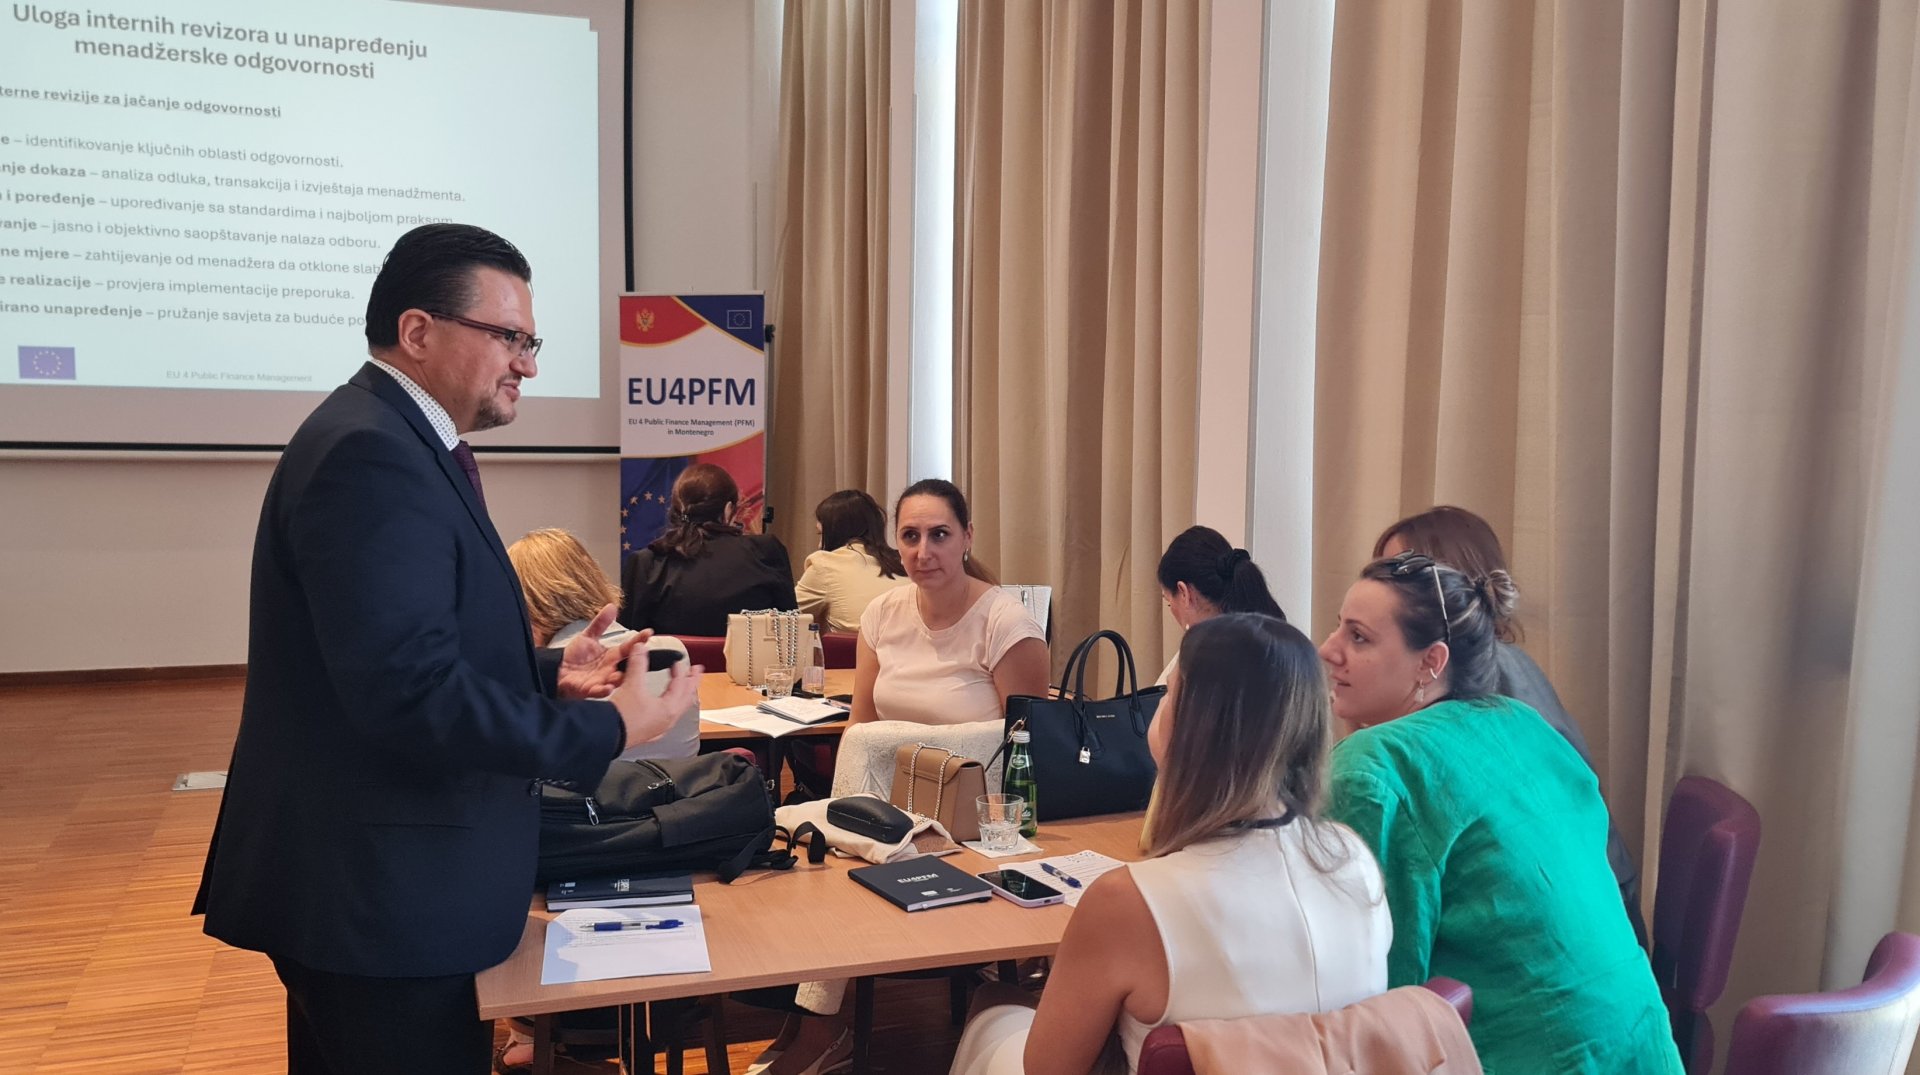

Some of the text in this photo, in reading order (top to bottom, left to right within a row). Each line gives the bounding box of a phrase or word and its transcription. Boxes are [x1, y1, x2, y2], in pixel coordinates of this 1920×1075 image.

[13, 3, 427, 61] Uloga internih revizora u unapređenju
[75, 40, 375, 79] menadžerske odgovornosti
[44, 90, 100, 105] revizije
[104, 96, 121, 105] za
[124, 94, 180, 112] jačanje
[184, 100, 282, 118] odgovornosti
[26, 134, 134, 155] identifikovanje
[138, 142, 195, 158] ključnih
[198, 147, 247, 161] oblasti
[250, 152, 344, 168] odgovornosti.
[30, 163, 87, 178] dokaza
[102, 169, 154, 182] analiza
[157, 172, 212, 187] odluka,
[214, 176, 291, 193] transakcija
[302, 180, 364, 198] izvještaja
[366, 186, 466, 203] menadžmenta.
[6, 189, 11, 201] i
[208, 204, 226, 216] sa
[228, 204, 317, 219] standardima
[327, 209, 394, 226] najboljom
[52, 219, 93, 234] jasno
[104, 224, 181, 239] objektivno
[184, 229, 278, 246] saopštavanje
[281, 233, 326, 247] nalaza
[329, 236, 381, 250] odboru.
[24, 246, 71, 261] mjere
[85, 250, 173, 267] zahtijevanje
[176, 254, 194, 267] od
[198, 256, 275, 271] menadžera
[278, 259, 297, 271] da
[299, 260, 350, 274] otklone
[10, 274, 92, 290] realizacije
[106, 278, 166, 293] provjera
[169, 280, 279, 298] implementacije
[282, 288, 355, 303] preporuka.
[158, 307, 220, 322] pružanje
[222, 310, 272, 325] savjeta
[275, 314, 291, 325] za
[294, 312, 345, 326] buduće
[166, 370, 181, 379] EU
[191, 372, 219, 380] Public
[220, 372, 255, 381] Finance
[257, 374, 313, 383] Management
[628, 378, 755, 406] EU4PFM
[644, 418, 664, 426] Public
[665, 418, 689, 426] Finance
[690, 418, 733, 428] Management
[734, 419, 755, 428] (PFM)
[675, 428, 714, 437] Montenegro
